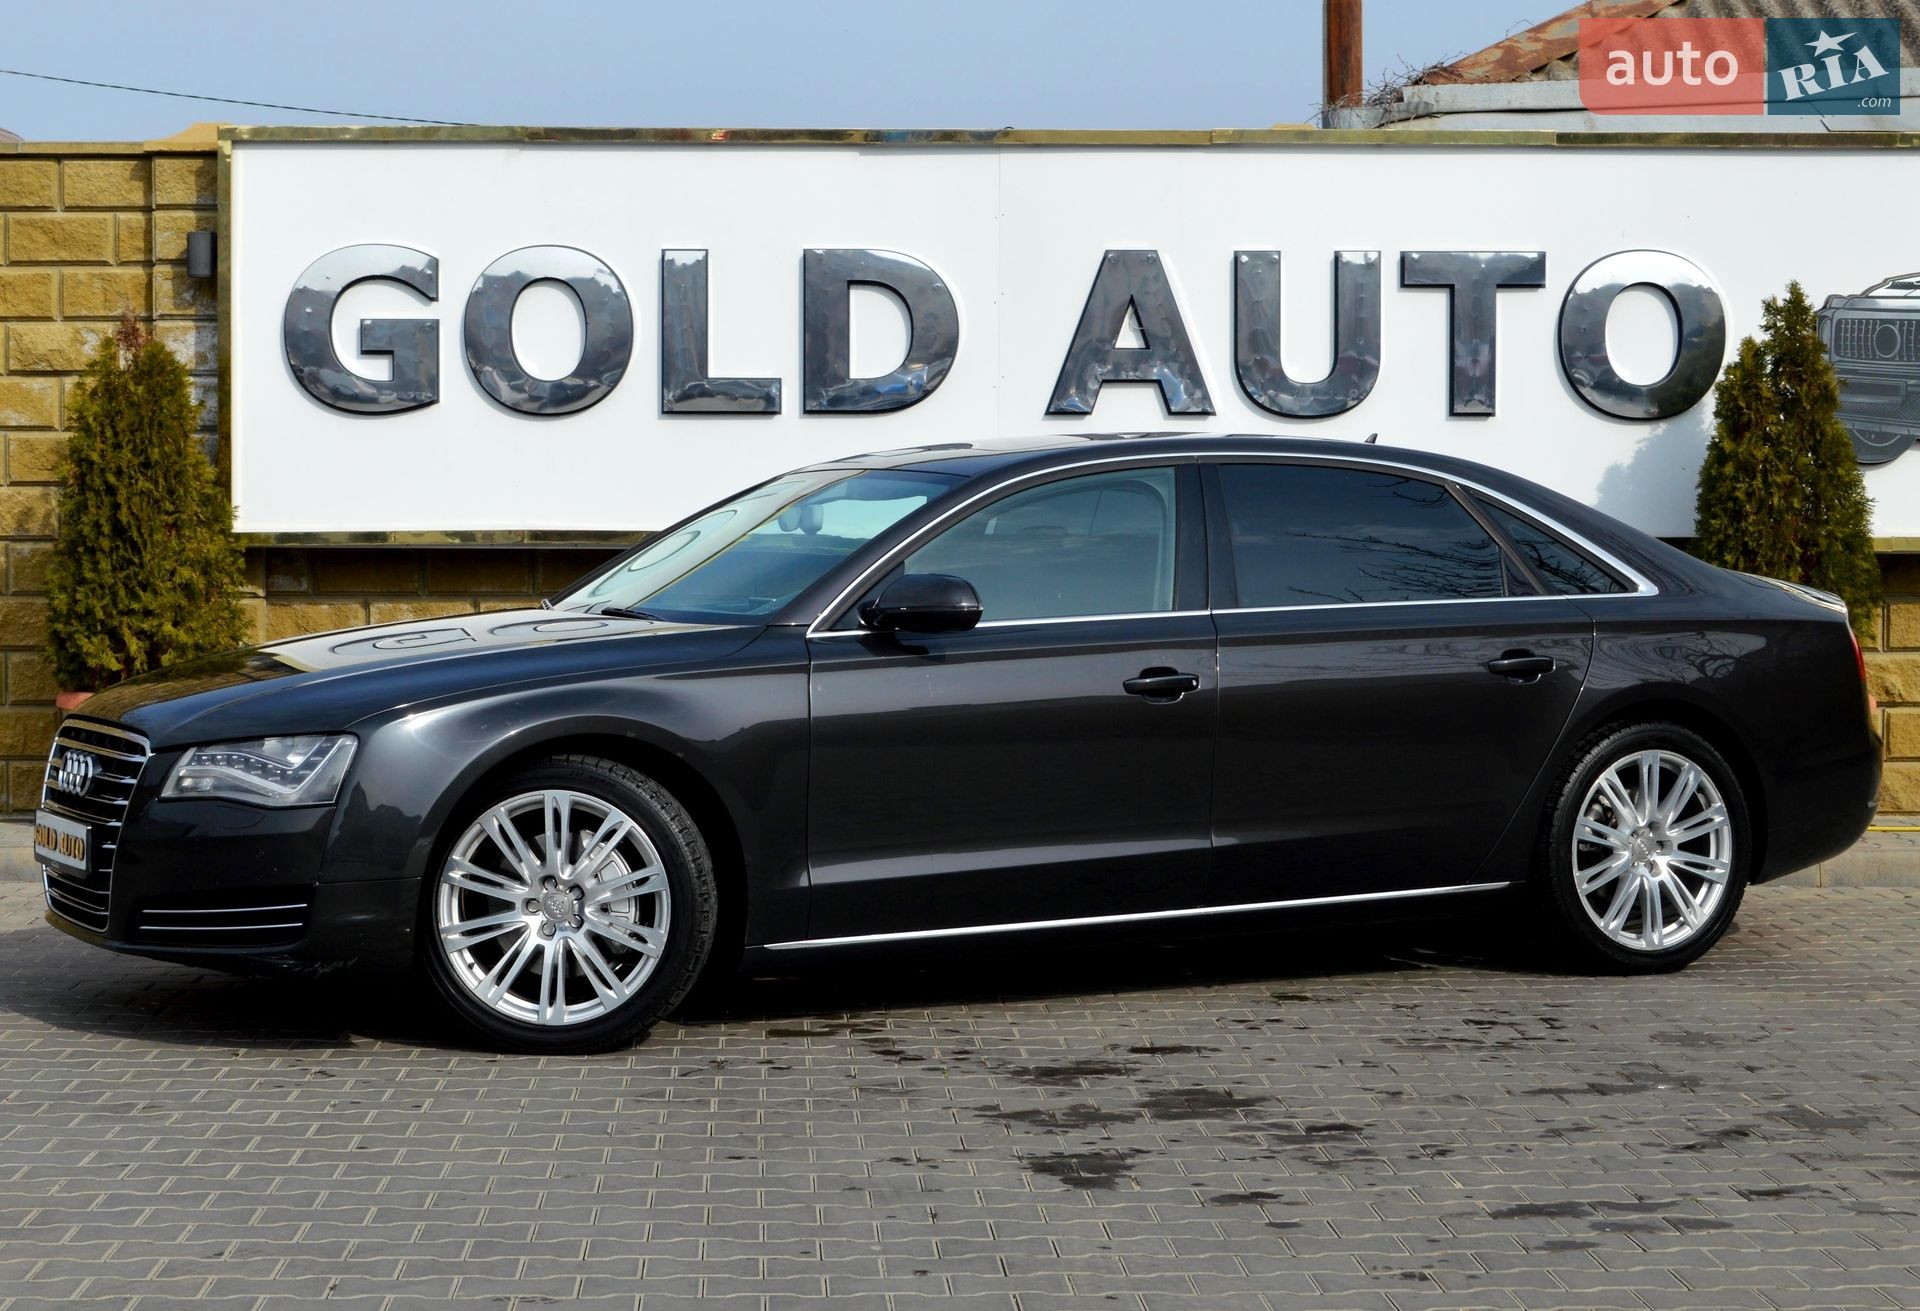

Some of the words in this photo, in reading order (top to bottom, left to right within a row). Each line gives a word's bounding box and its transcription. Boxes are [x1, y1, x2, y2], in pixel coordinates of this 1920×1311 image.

[284, 244, 959, 415] GOLD
[1045, 249, 1726, 419] AUTO
[59, 832, 85, 861] AUTO
